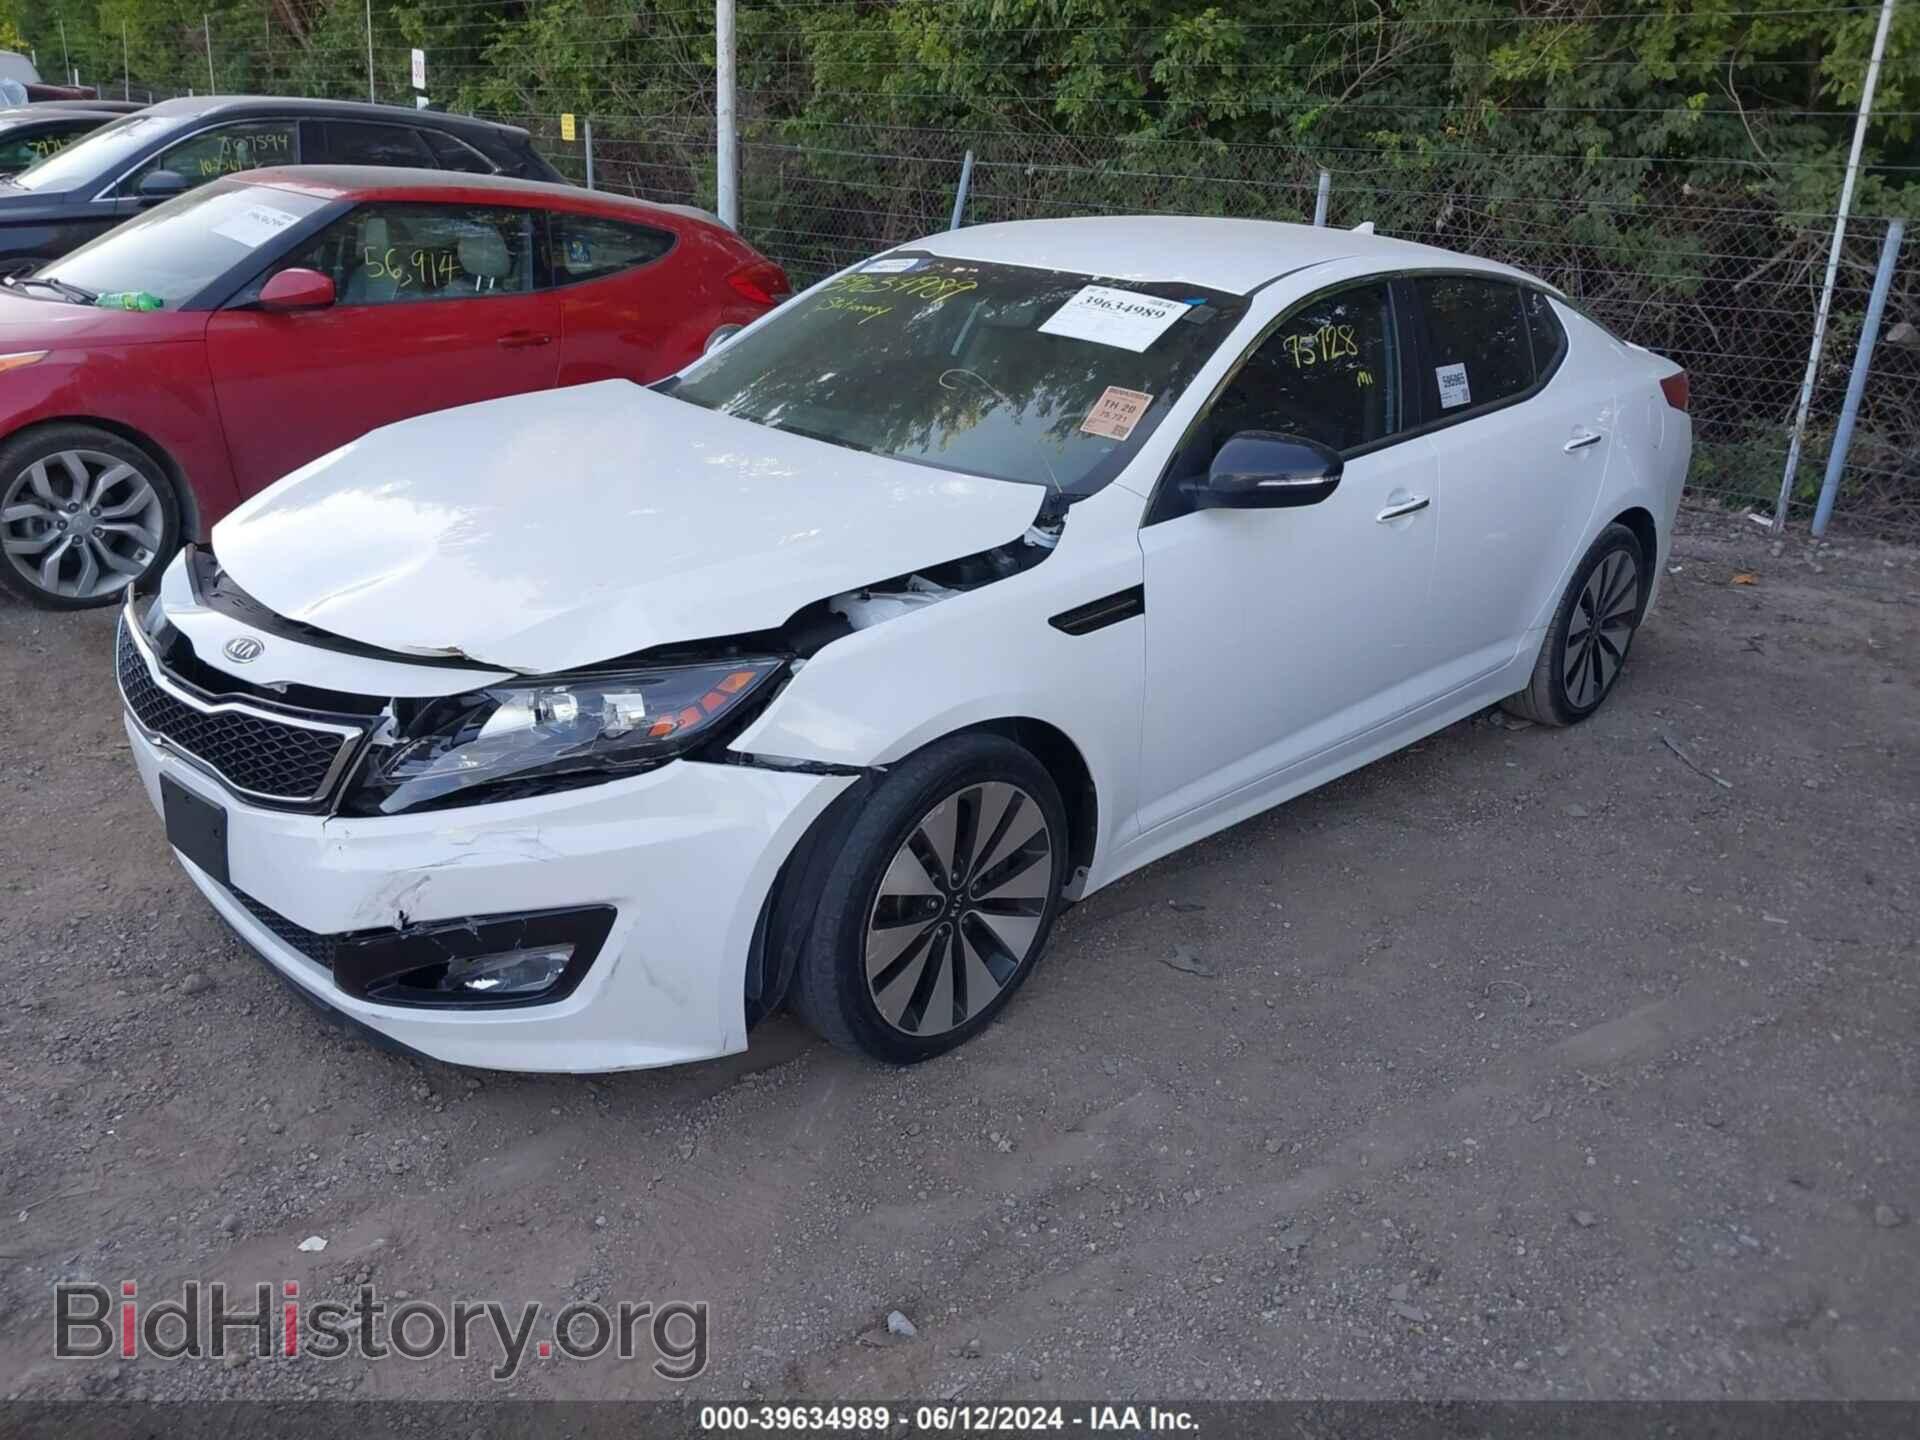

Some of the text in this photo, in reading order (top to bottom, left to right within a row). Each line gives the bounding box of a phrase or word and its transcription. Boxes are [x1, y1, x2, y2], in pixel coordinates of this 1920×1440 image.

[364, 247, 461, 288] 56,914
[1082, 295, 1167, 320] 39634989
[1283, 324, 1358, 368] 75728
[231, 639, 256, 658] KIA
